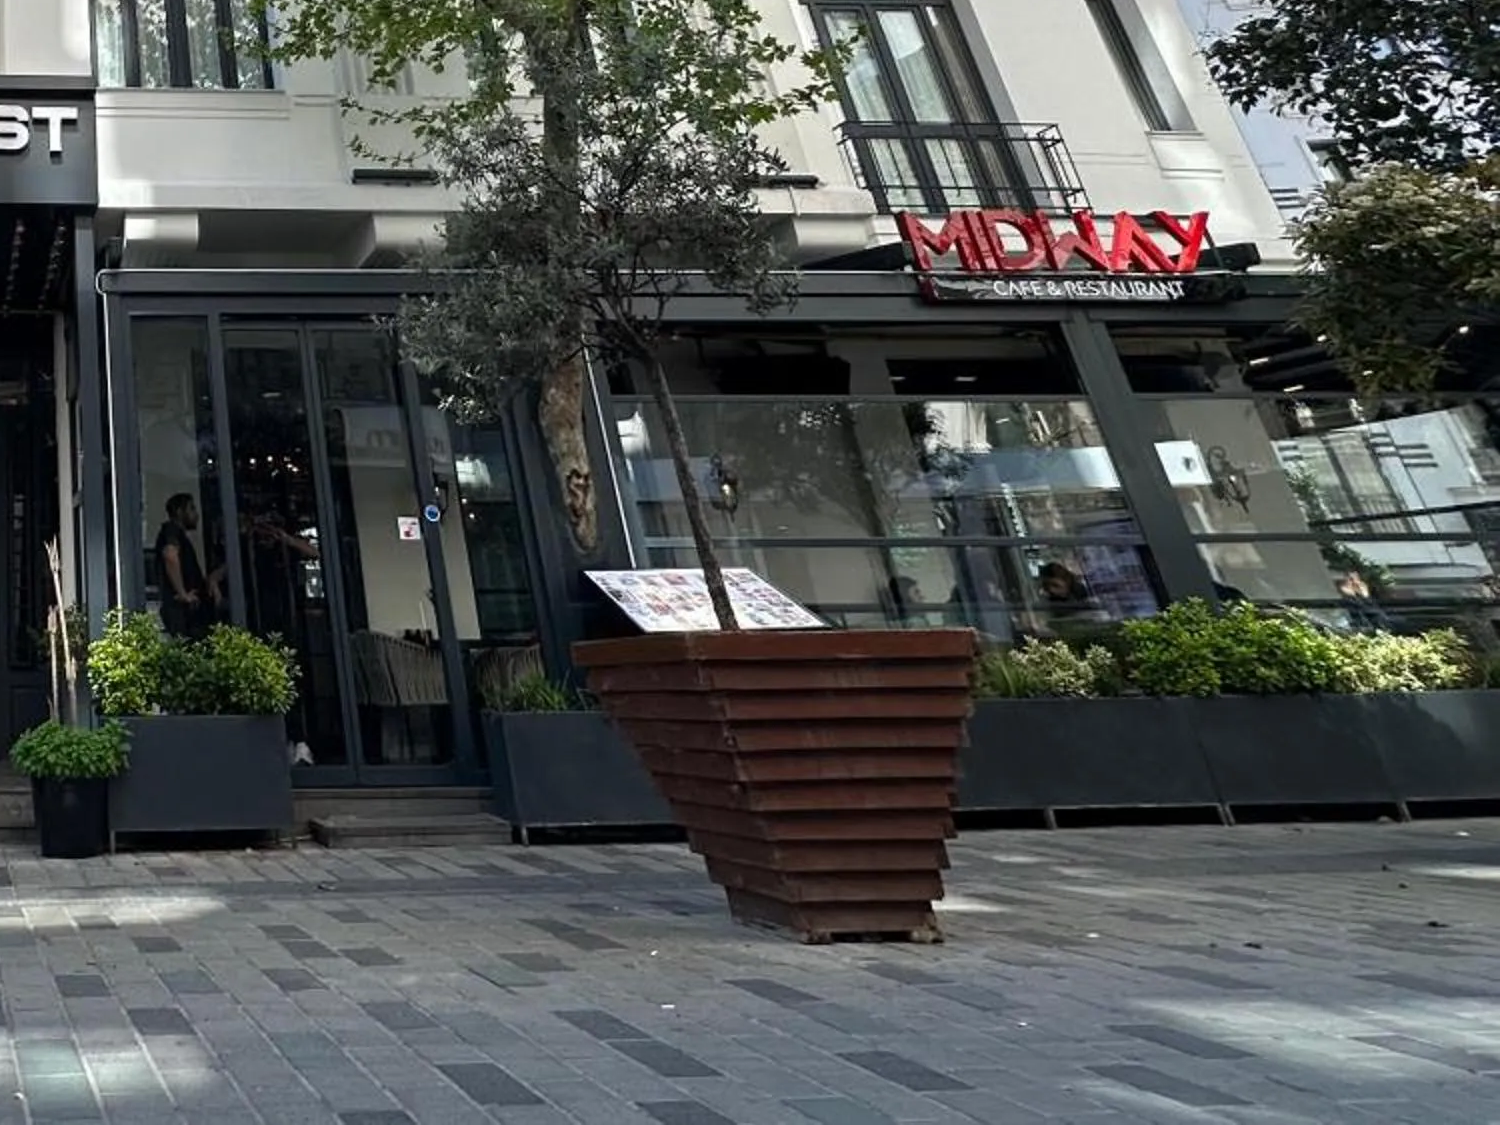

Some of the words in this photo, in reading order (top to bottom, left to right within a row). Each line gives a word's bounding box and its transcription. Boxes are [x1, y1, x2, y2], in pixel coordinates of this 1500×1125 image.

[899, 210, 1209, 272] MIDWAY
[993, 280, 1042, 296] CAFE
[1047, 280, 1061, 296] &
[1064, 280, 1185, 298] RESTAURANT
